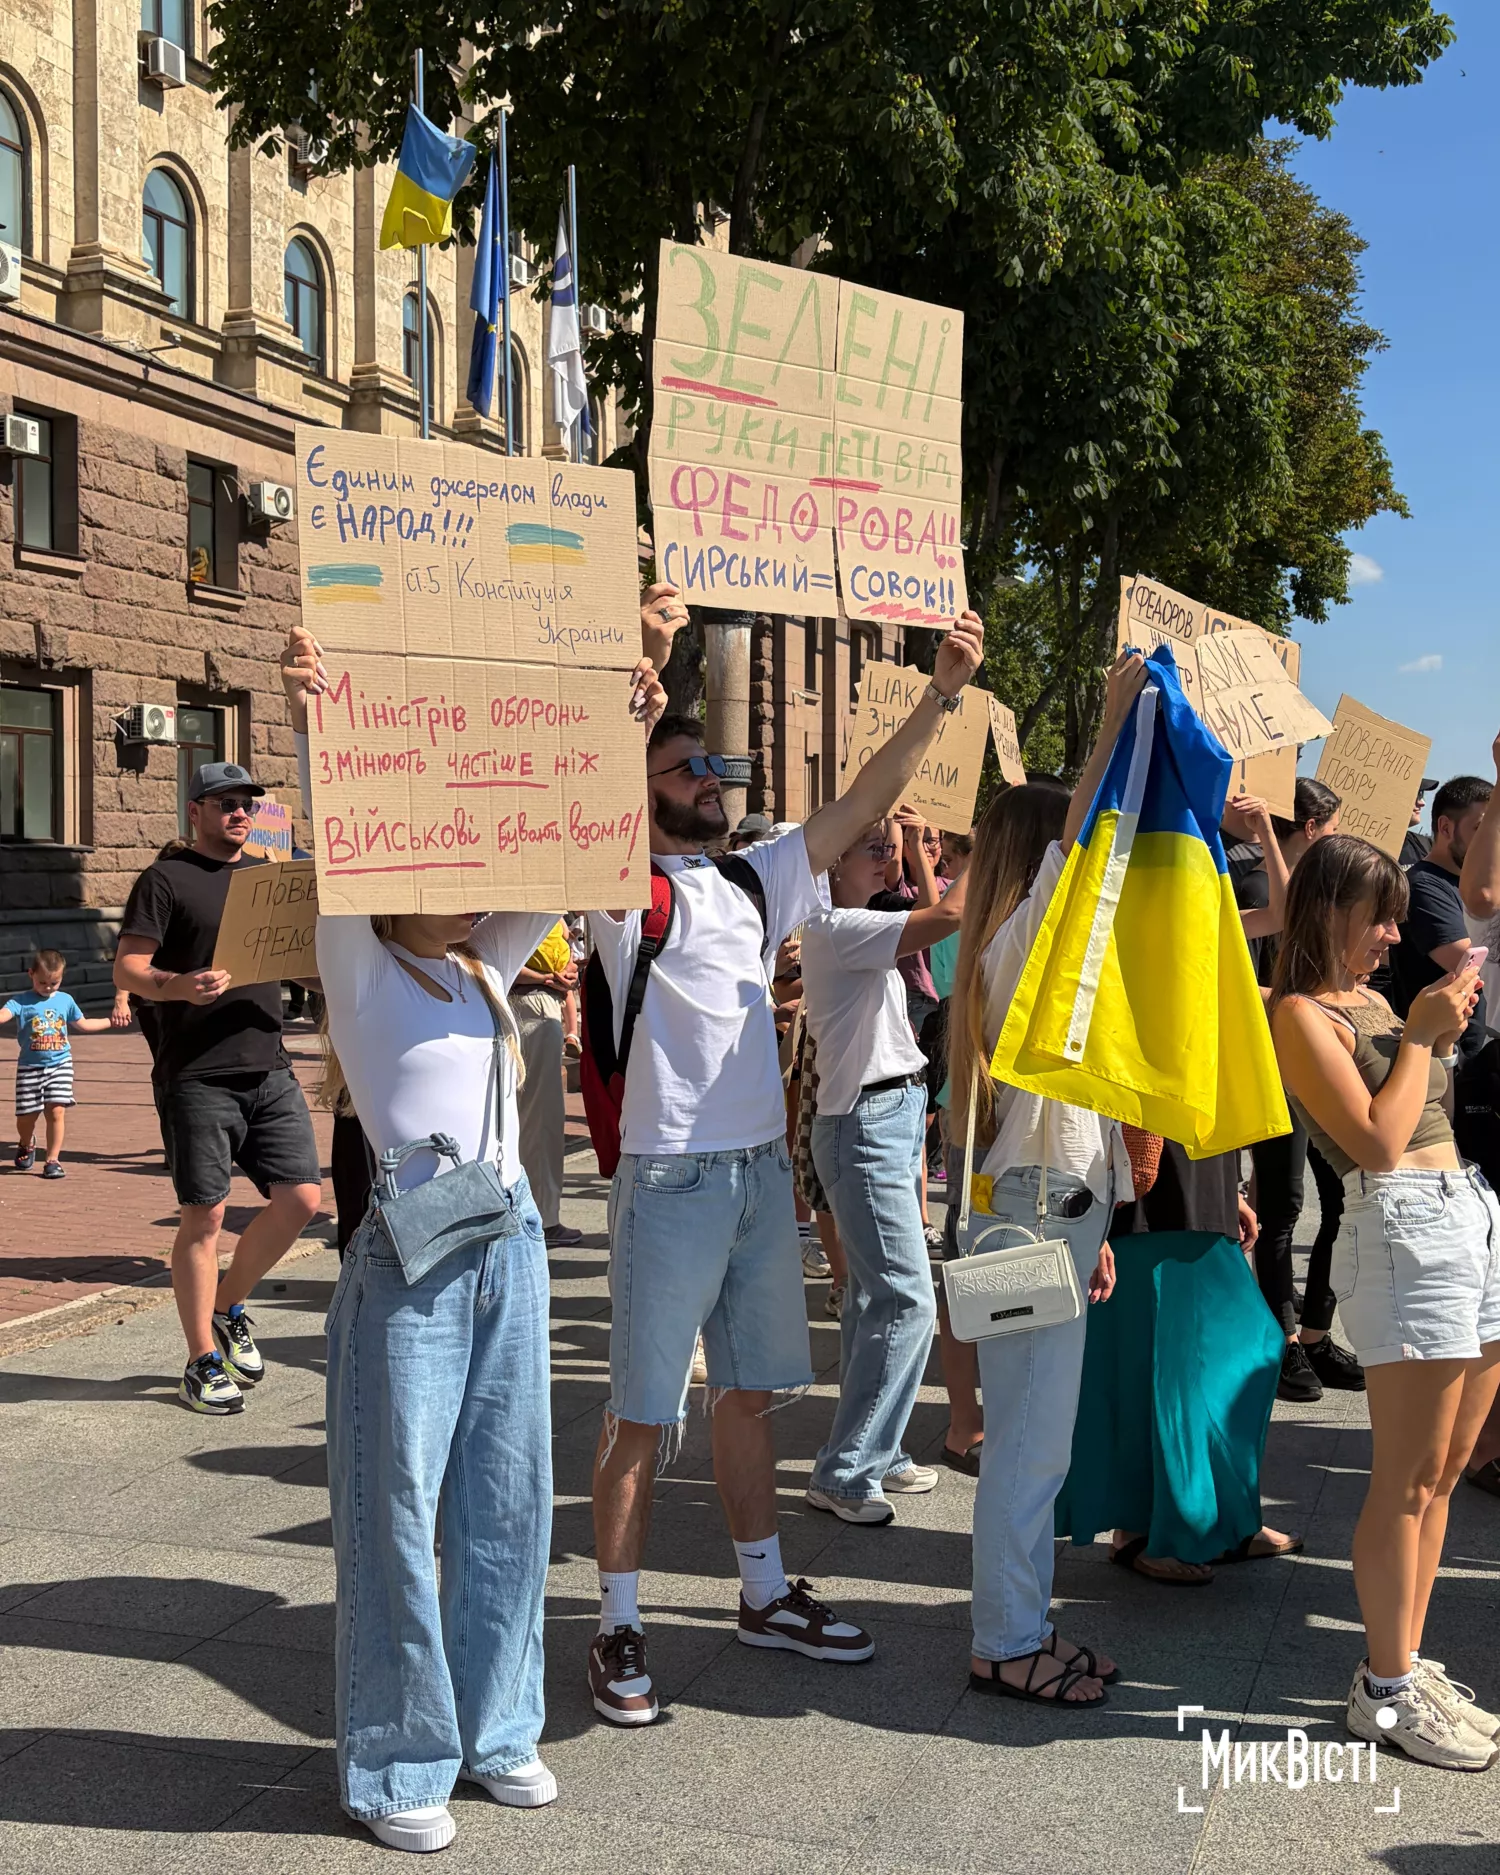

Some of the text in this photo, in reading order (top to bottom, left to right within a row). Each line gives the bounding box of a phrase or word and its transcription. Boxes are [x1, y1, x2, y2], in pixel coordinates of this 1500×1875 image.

[669, 246, 951, 422] ЗЕЛЕНІ
[666, 395, 952, 488] РУКИ ГЕТЬ ВІД
[430, 476, 536, 512] джерелом
[551, 472, 608, 518] влади
[669, 464, 957, 570] ФЕДОРОВА!!
[336, 500, 474, 549] НАРОД!!!
[455, 557, 573, 612] Конституція
[850, 565, 955, 616] СОВОК!!
[538, 616, 624, 655] України
[1135, 585, 1194, 639] ФЕДОРОВ
[316, 671, 467, 747] Міністрів
[1195, 692, 1285, 751] НУЛЕ
[446, 748, 534, 780] ЧАСТІШЕ
[1333, 720, 1415, 780] ПОВЕРНІТЬ
[1319, 757, 1377, 801] ДОВІРУ
[325, 806, 481, 864] Військові
[1336, 803, 1392, 841] ЮДЕЙ
